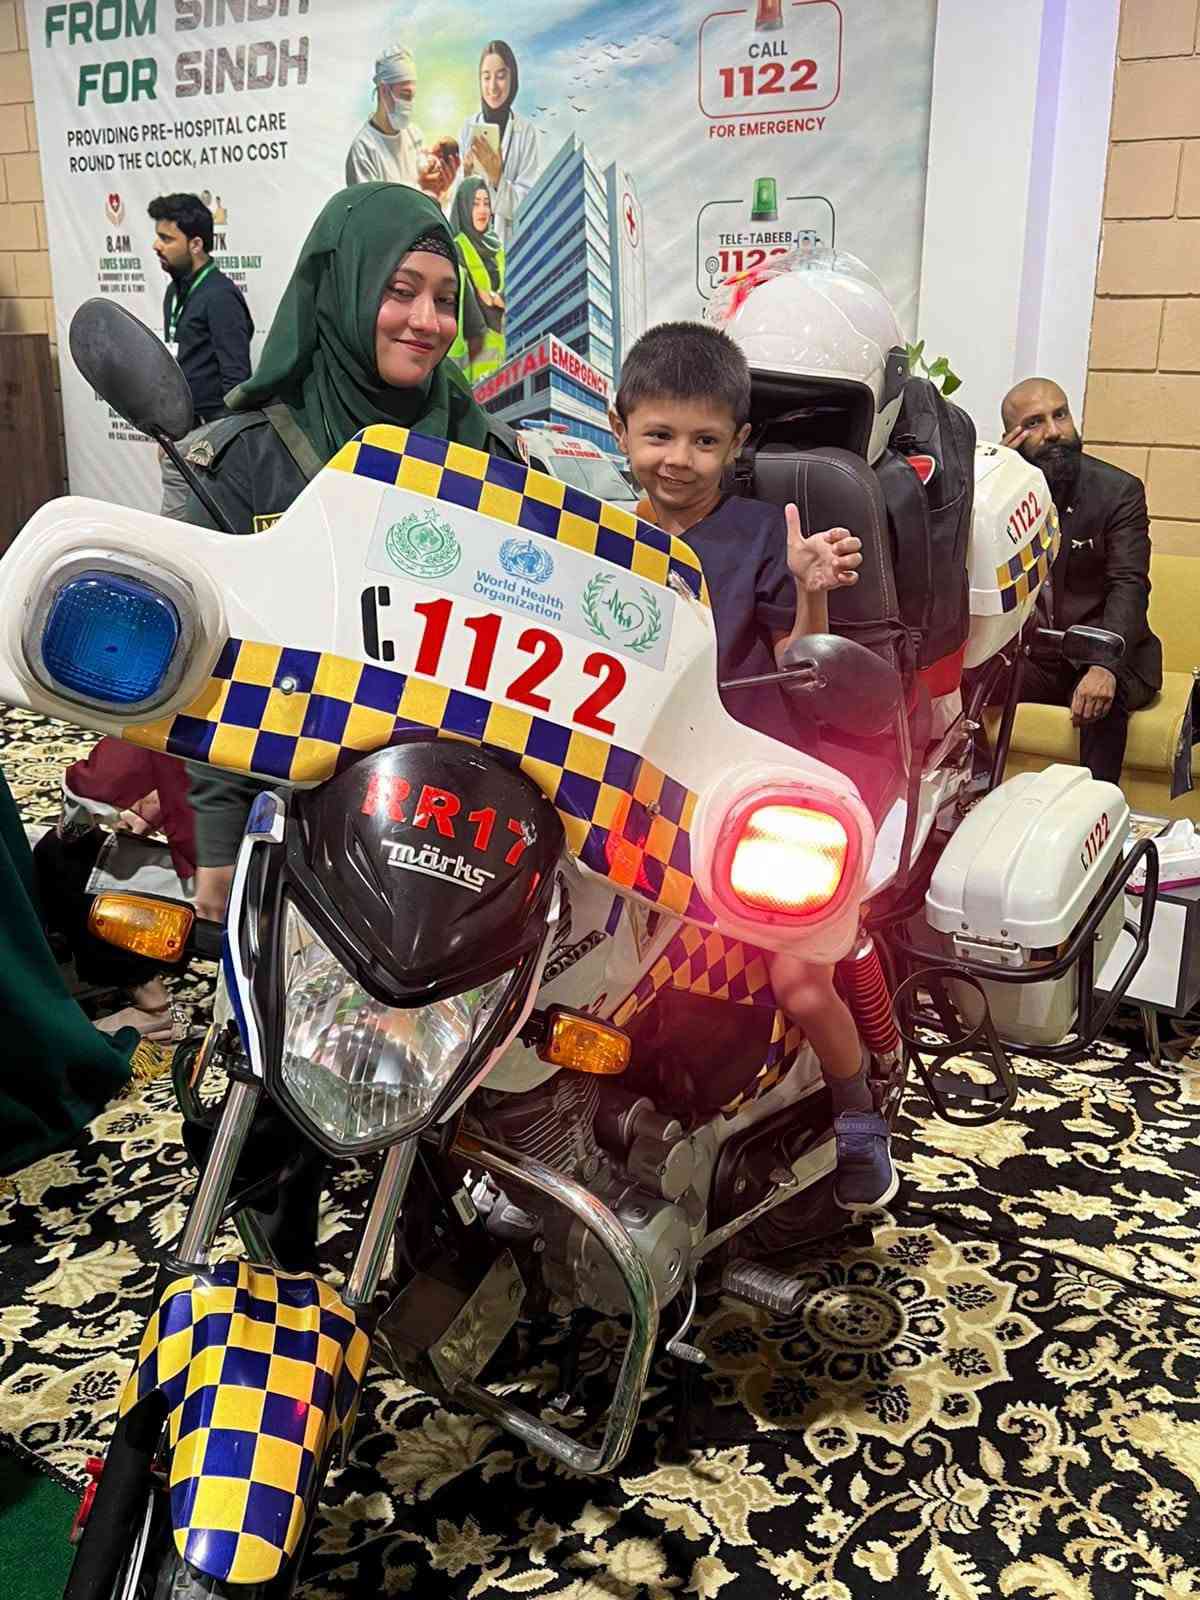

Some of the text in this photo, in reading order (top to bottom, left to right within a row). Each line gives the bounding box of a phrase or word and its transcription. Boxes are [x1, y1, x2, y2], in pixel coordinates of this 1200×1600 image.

[45, 0, 157, 48] FROM
[748, 40, 788, 59] CALL
[77, 36, 310, 107] FOR SINDH
[719, 59, 818, 99] 1122
[67, 112, 287, 148] PROVIDING PRE-HOSPITAL CARE
[708, 116, 827, 139] FOR EMERGENCY
[69, 141, 289, 173] ROUND THE CLOCK, AT NO COST
[213, 232, 227, 250] 7K
[719, 231, 793, 245] TELE-TABEEB
[718, 247, 788, 273] 112
[474, 344, 549, 403] OSPITAL
[551, 341, 609, 396] EMERGENCY
[1008, 490, 1042, 540] 1122
[472, 581, 563, 621] Organization
[475, 570, 564, 611] World Health
[413, 598, 628, 736] 1122
[1084, 812, 1111, 864] 1122
[543, 931, 603, 983] ONDA
